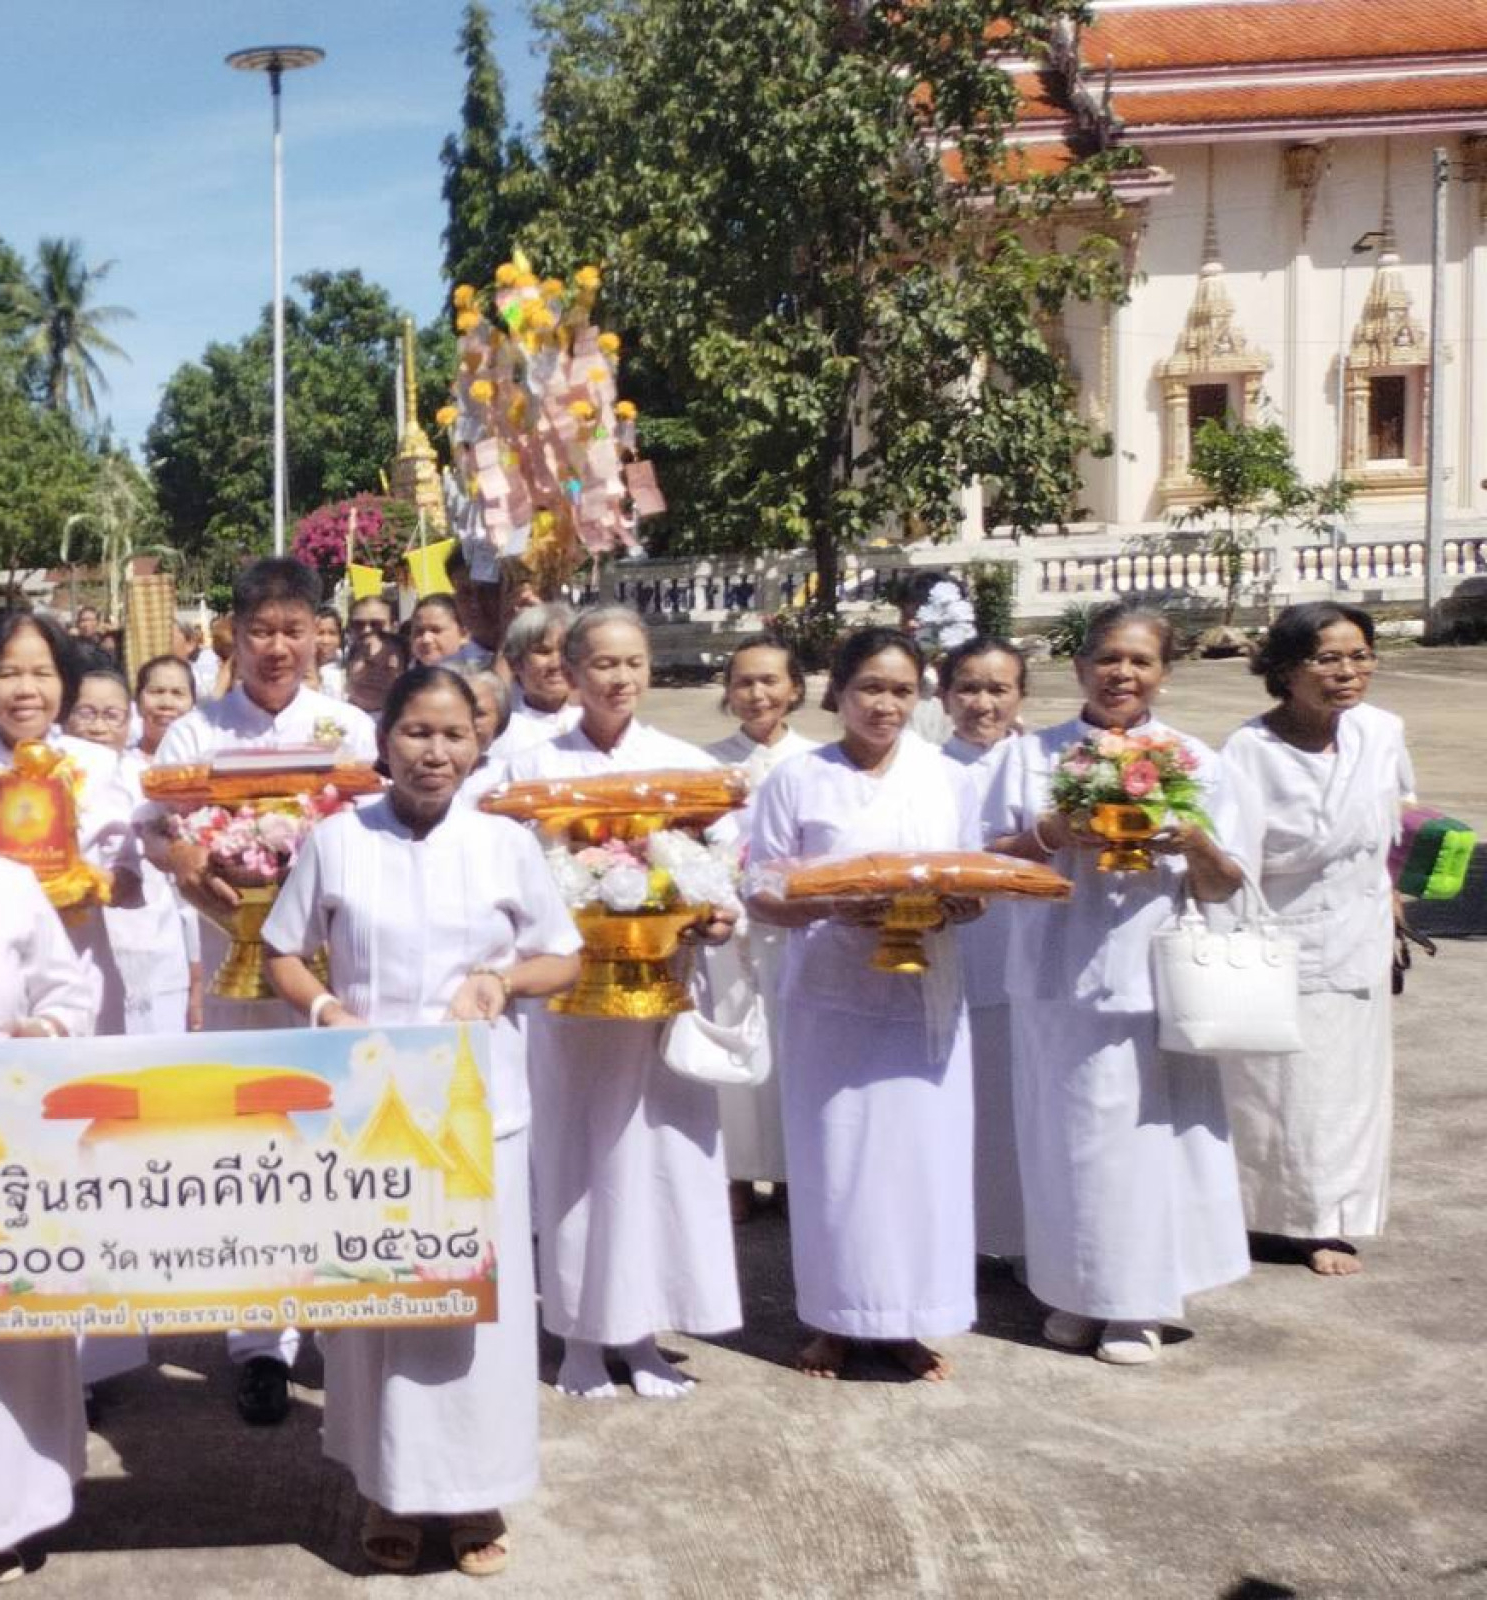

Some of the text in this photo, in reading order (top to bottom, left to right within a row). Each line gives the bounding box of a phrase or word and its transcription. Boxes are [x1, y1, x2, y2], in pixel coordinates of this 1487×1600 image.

[99, 1240, 138, 1271] วัด
[149, 1236, 319, 1281] พุทธศักราช
[334, 1227, 480, 1263] ๒๕๖๘
